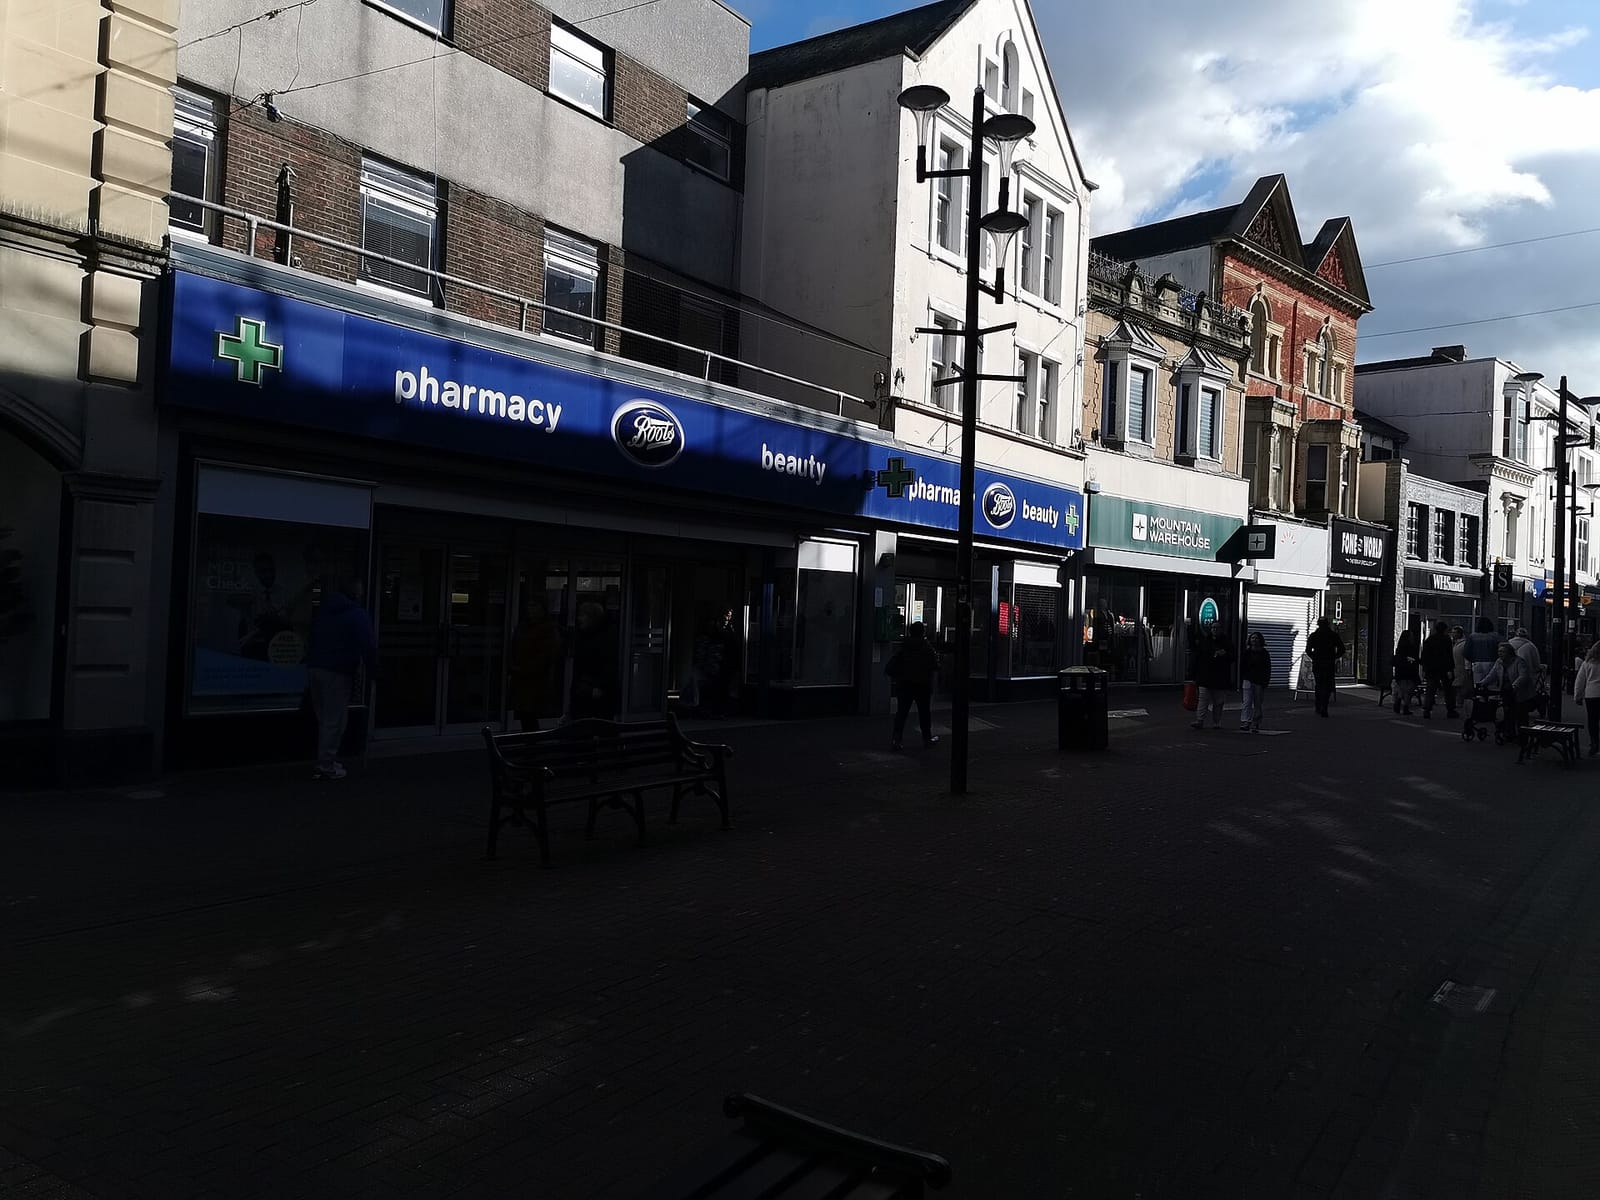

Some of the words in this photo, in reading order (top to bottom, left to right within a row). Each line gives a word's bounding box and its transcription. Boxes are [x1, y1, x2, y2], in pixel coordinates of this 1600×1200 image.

[395, 367, 563, 433] pharmacy
[628, 414, 676, 451] Boots
[760, 443, 827, 485] beauty
[909, 476, 961, 506] pharma
[991, 493, 1013, 519] Boots
[1023, 500, 1059, 528] beauty
[1150, 516, 1201, 533] MOUNTAIN
[1149, 531, 1210, 548] WAREHOUSE
